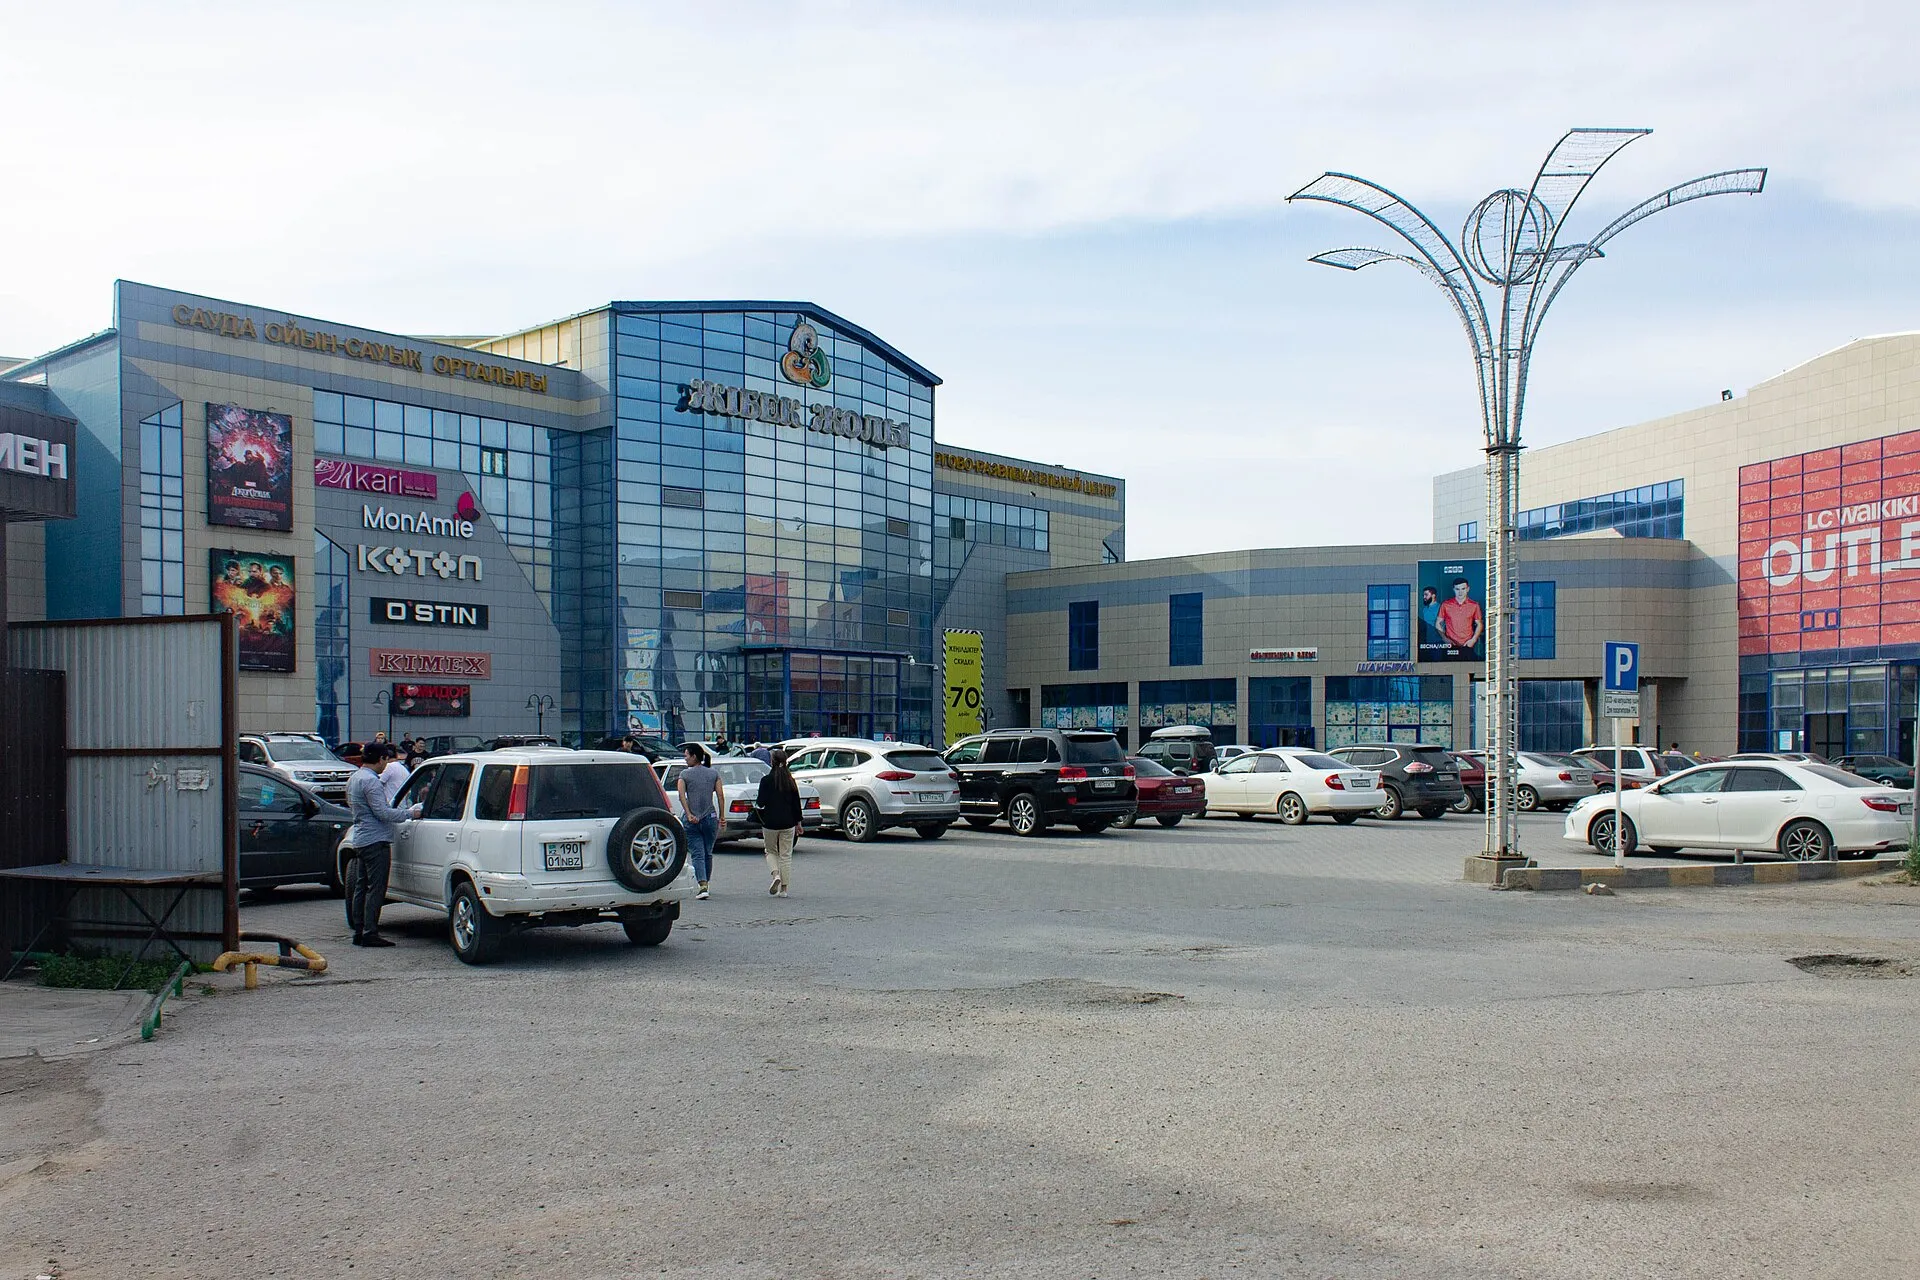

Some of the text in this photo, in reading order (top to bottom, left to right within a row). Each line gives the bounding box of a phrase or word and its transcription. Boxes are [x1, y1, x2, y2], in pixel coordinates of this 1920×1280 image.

[171, 303, 549, 393] САУДА ОЙЫН-САУЫҚ ОРТАЛЫҒЫ
[688, 378, 910, 449] ЖІБЕК ЖОЛЫ
[355, 465, 403, 494] kari
[363, 504, 474, 538] MonAmie
[1807, 510, 1833, 531] LC
[379, 653, 485, 675] KIMEX
[1615, 647, 1633, 686] P
[548, 856, 580, 866] 01 NBZ
[560, 843, 578, 854] 190
